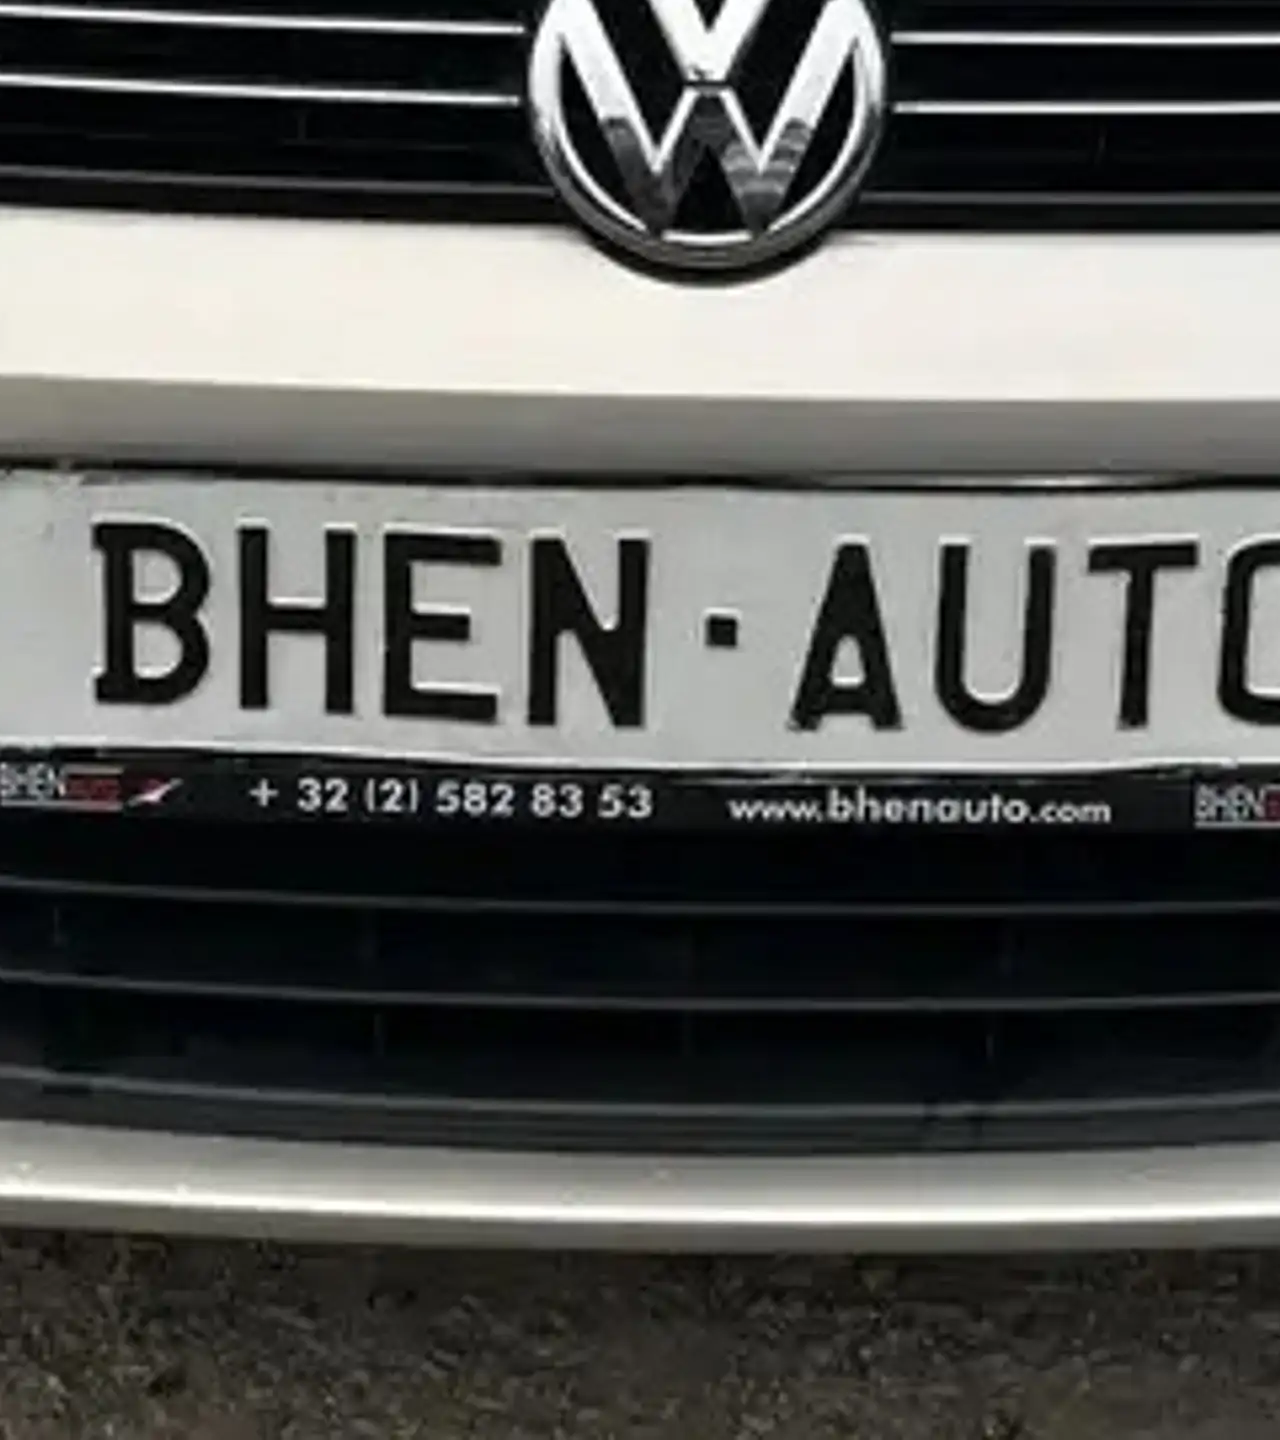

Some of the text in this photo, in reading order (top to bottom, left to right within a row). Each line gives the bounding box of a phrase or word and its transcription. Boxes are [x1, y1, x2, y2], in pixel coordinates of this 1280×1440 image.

[92, 522, 650, 728] BHEN
[297, 778, 348, 812] 32
[365, 778, 419, 814] (2)
[435, 780, 515, 815] 582
[531, 783, 584, 818] 83
[597, 783, 653, 819] 53
[728, 786, 1112, 823] www.bhenauto.com
